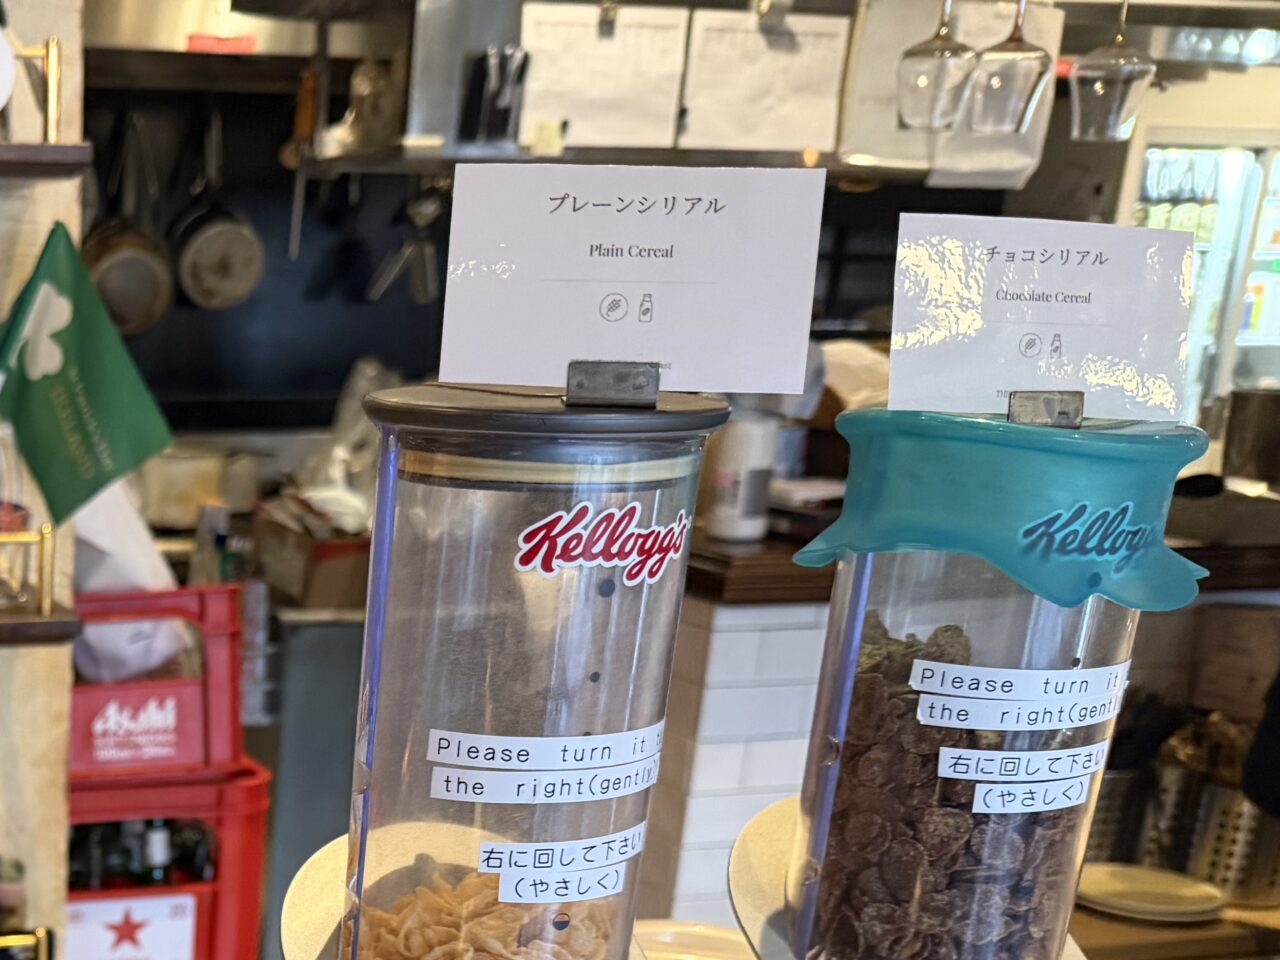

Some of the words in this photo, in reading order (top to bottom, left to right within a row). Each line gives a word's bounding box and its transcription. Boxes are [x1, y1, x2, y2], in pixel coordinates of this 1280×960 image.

[548, 192, 727, 216] プレーンシリアル
[589, 243, 624, 258] Plain
[627, 244, 674, 259] Cereal
[984, 245, 1110, 267] チョコシリアル
[995, 288, 1053, 304] Chocolate
[1054, 290, 1092, 305] Cereal
[517, 503, 688, 584] Kellogg's
[920, 668, 1014, 693] Please
[1042, 677, 1089, 695] turn
[1106, 671, 1120, 690] it
[927, 702, 969, 722] the
[436, 738, 531, 763] Please
[561, 744, 612, 762] turn
[632, 735, 646, 756] it
[948, 748, 1105, 776] 右に回して下さい
[443, 775, 486, 796] the
[481, 833, 641, 869] 右に回して下さい
